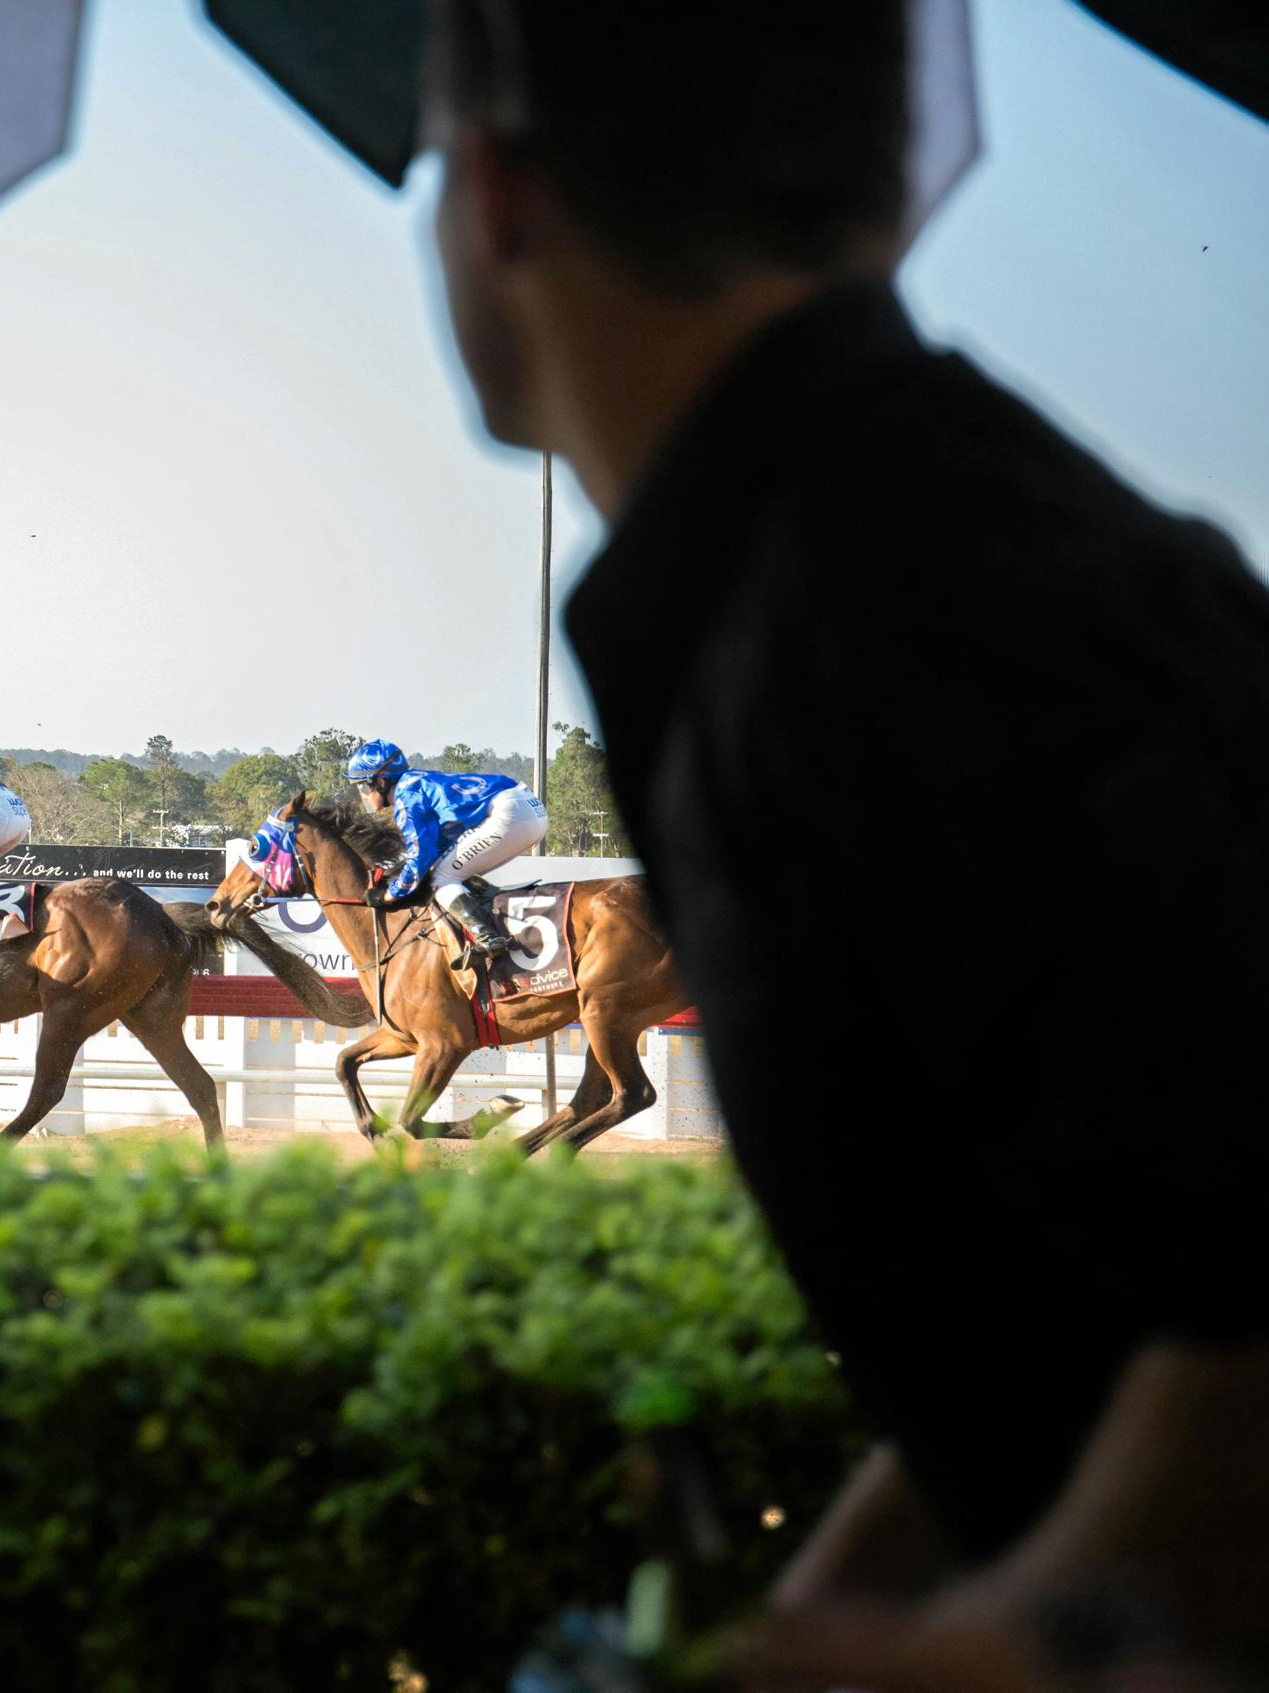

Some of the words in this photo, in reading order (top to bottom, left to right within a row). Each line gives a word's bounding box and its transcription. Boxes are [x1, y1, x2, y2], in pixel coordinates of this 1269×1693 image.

[451, 831, 503, 871] O'BRIEN
[93, 868, 113, 877] and
[117, 869, 144, 879] we'll
[147, 869, 161, 879] do
[165, 870, 183, 880] the
[187, 872, 209, 880] rest
[507, 895, 559, 971] 5
[300, 953, 355, 970] own
